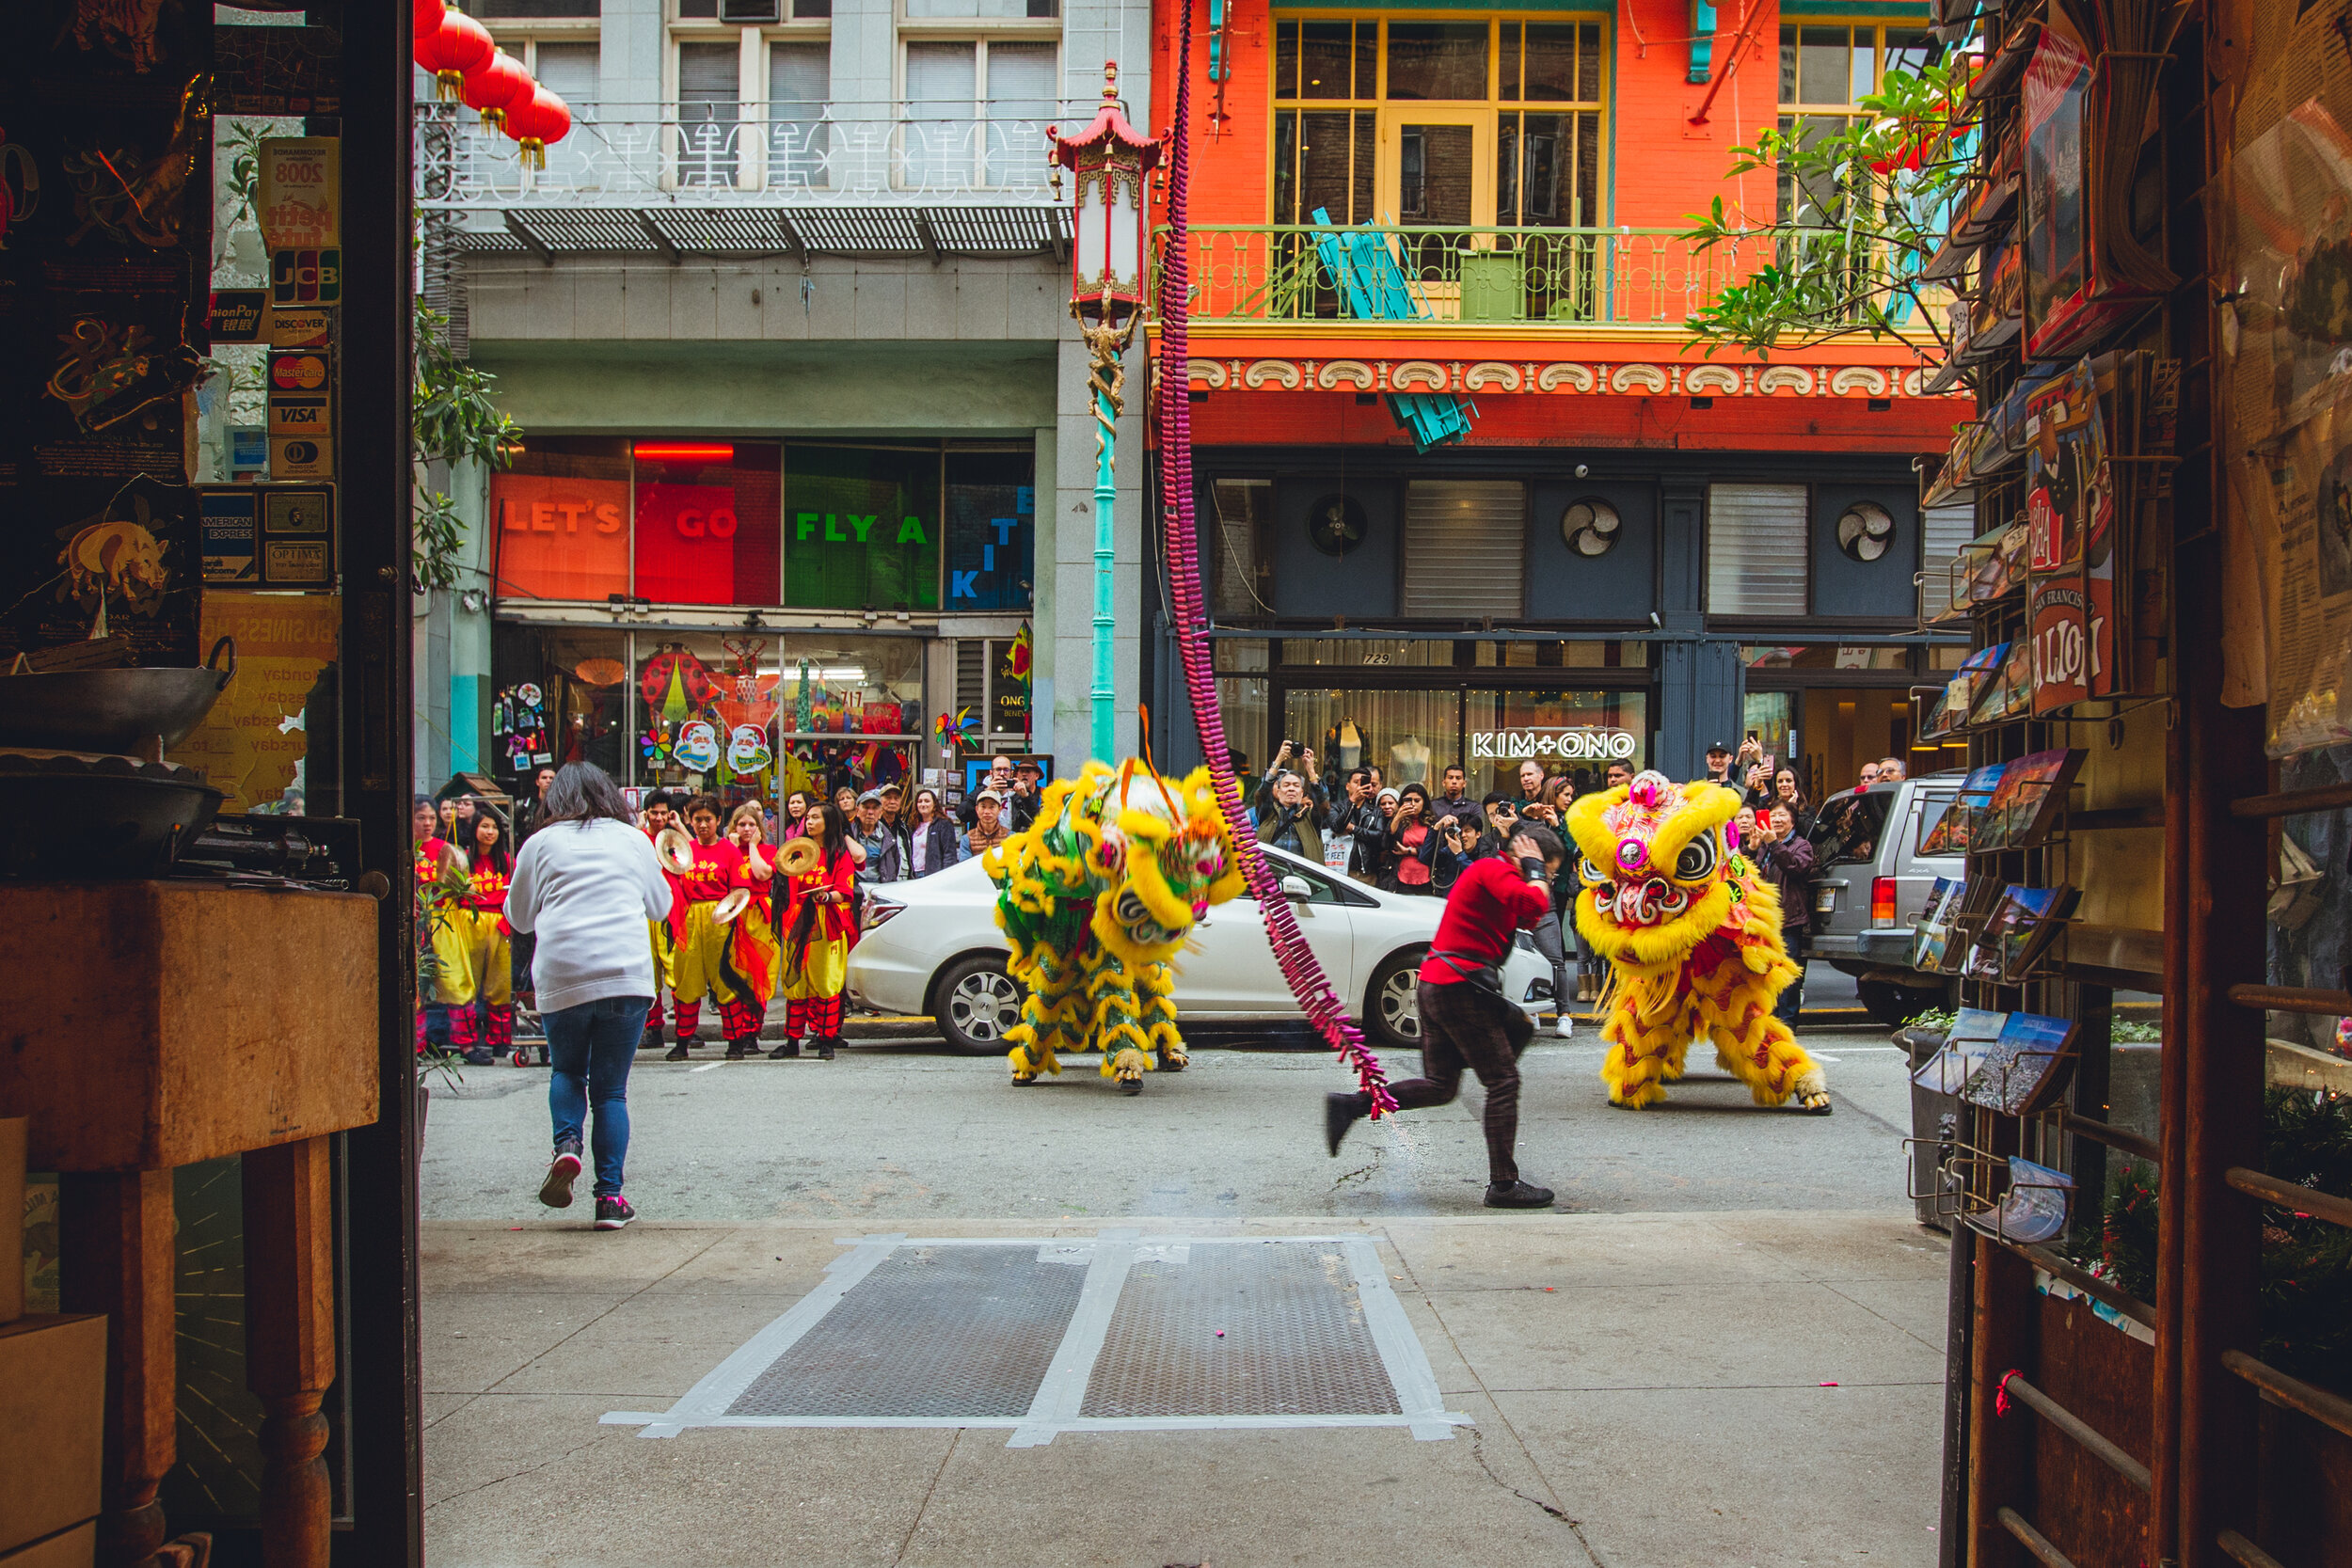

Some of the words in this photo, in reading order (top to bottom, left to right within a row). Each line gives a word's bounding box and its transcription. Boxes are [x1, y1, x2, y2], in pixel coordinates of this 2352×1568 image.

[274, 267, 340, 285] JCB
[211, 304, 260, 322] nionPay
[275, 318, 325, 328] DISCOVER
[274, 367, 325, 378] MasterCard
[280, 408, 317, 422] VISA
[201, 517, 252, 527] AMERICAN
[505, 499, 621, 534] LET'S
[676, 508, 738, 538] GO
[797, 513, 878, 542] FLY
[897, 516, 928, 544] A
[209, 530, 254, 539] EXPRESS
[1365, 654, 1390, 663] 729
[841, 691, 863, 707] 717
[1472, 732, 1636, 758] KIM+ONO
